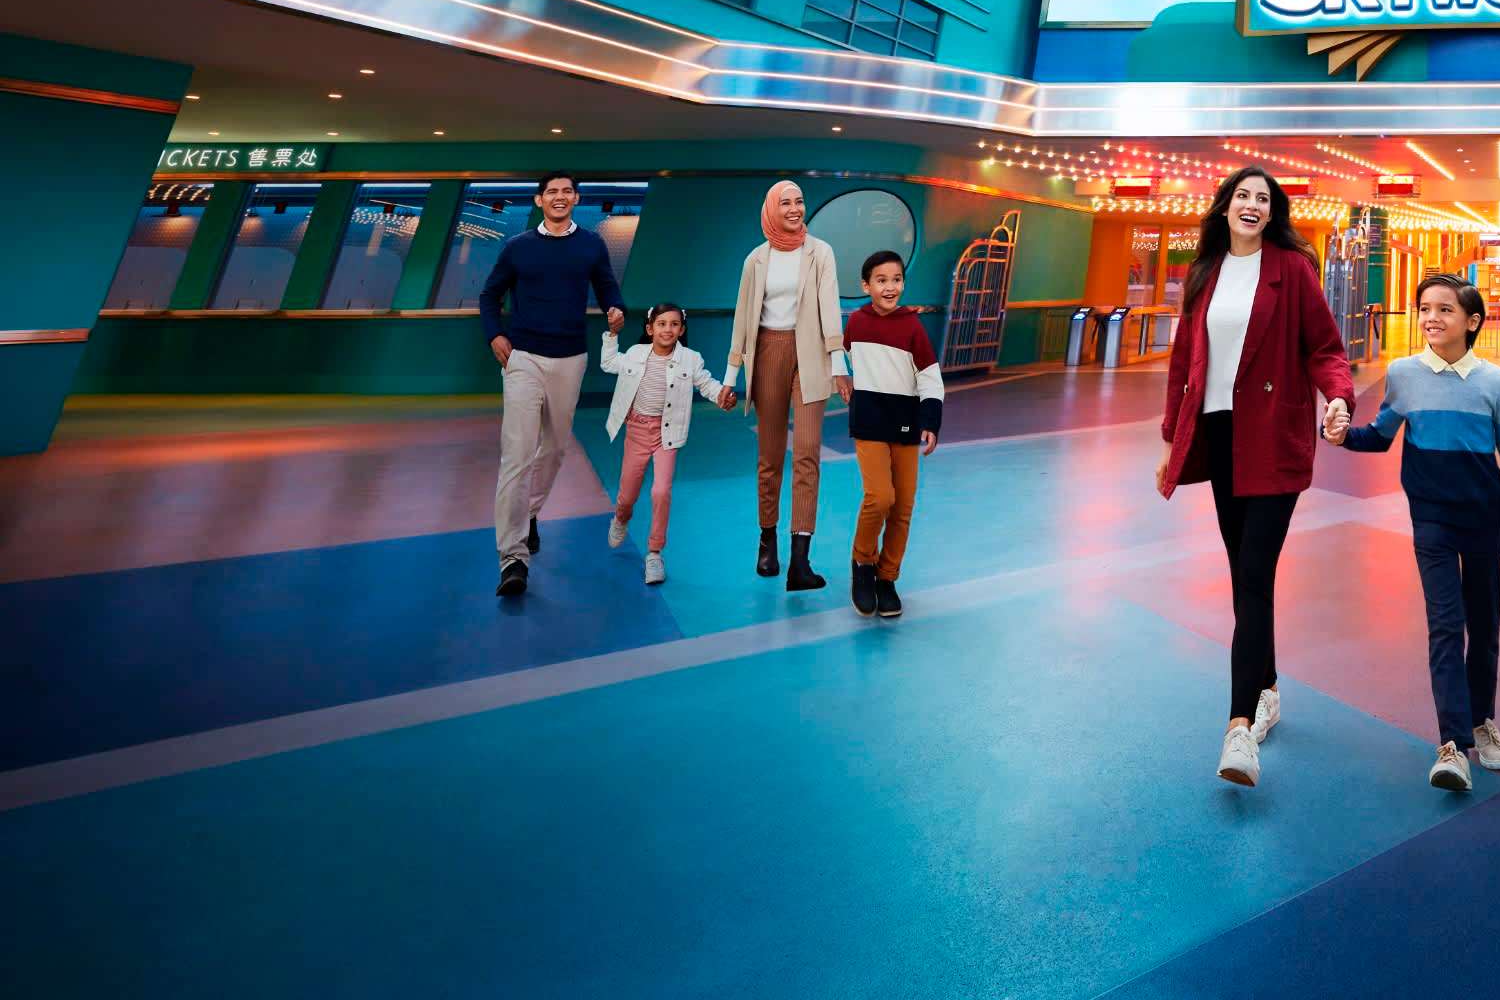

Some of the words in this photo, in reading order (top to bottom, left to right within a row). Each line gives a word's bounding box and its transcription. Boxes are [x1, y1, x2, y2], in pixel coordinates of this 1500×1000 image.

[157, 149, 239, 167] ICKETS
[248, 148, 317, 167] 售票处
